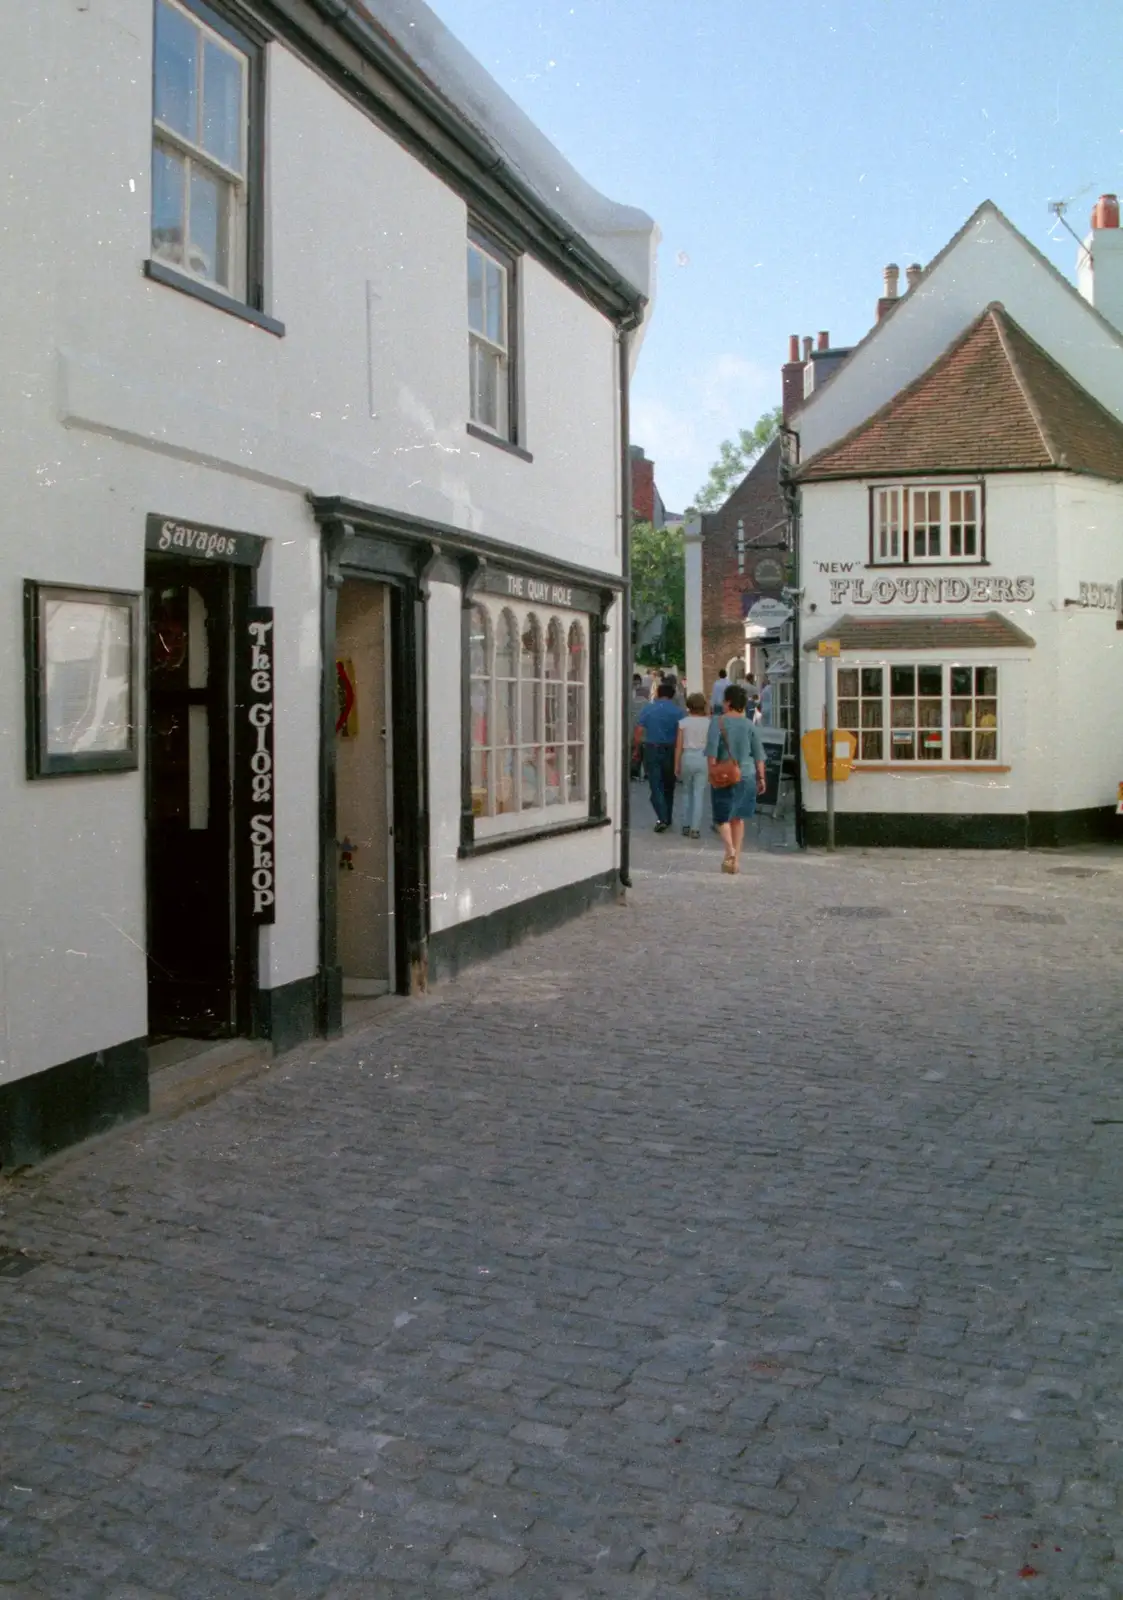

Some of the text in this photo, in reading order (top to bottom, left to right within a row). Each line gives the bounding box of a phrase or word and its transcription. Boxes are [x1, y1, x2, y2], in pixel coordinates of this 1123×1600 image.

[158, 520, 237, 558] Savages
[507, 574, 572, 606] THE QUAY HOLE
[829, 576, 1035, 605] FLOUNDERS
[248, 621, 273, 693] The
[249, 814, 274, 914] Shop
